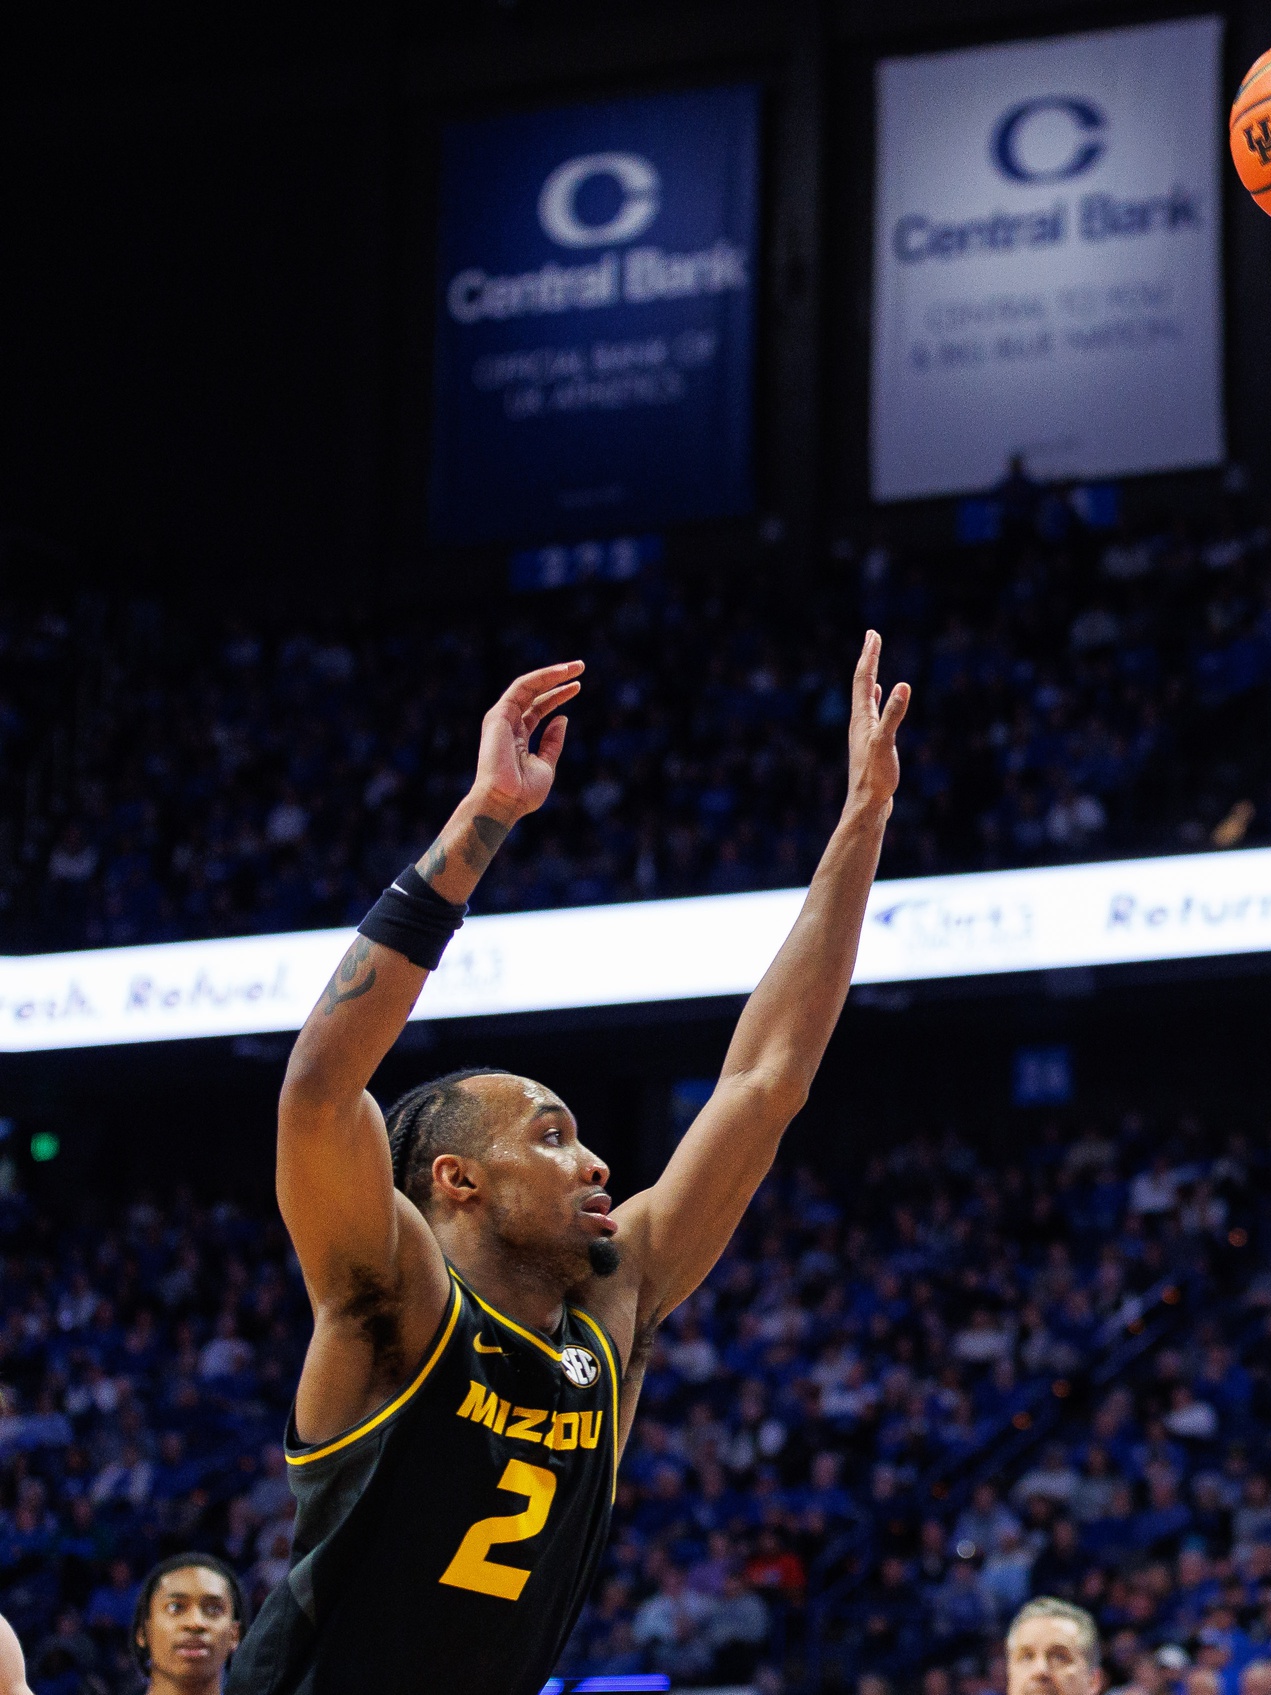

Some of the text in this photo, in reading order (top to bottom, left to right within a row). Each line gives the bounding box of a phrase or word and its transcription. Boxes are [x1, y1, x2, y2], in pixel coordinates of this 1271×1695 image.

[894, 185, 1201, 264] Central Bank
[449, 241, 748, 323] Central Bank
[562, 1348, 598, 1385] SEC
[438, 1459, 557, 1601] 2
